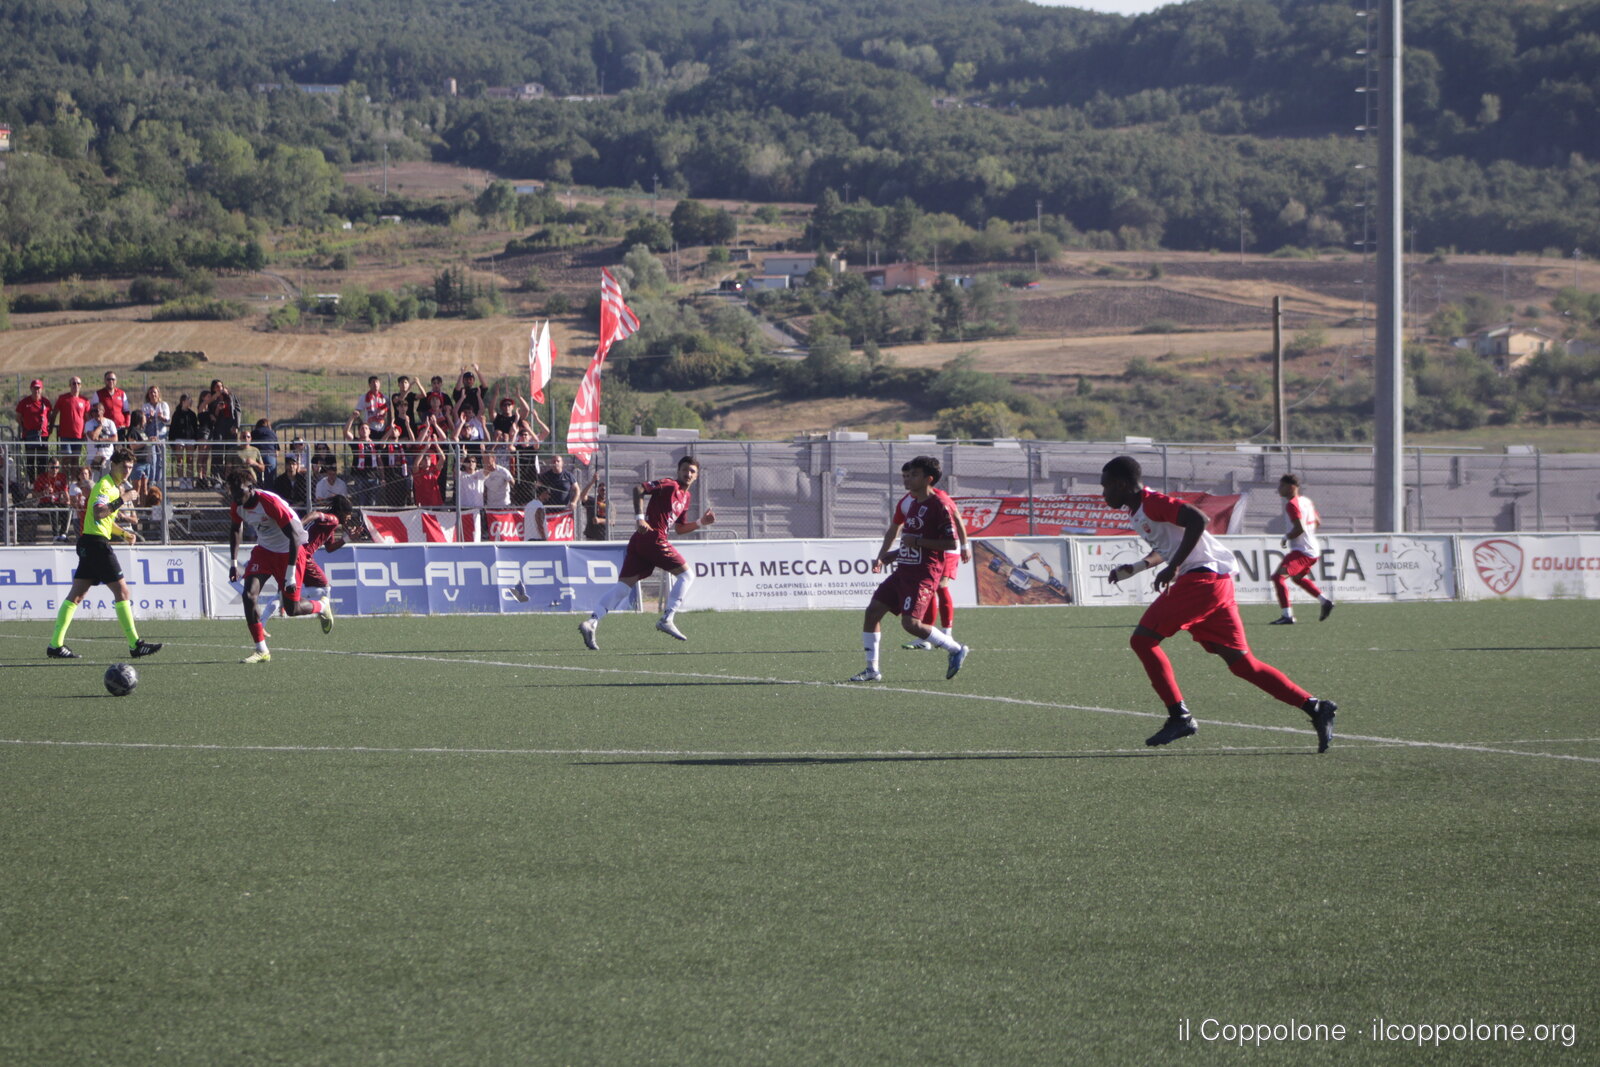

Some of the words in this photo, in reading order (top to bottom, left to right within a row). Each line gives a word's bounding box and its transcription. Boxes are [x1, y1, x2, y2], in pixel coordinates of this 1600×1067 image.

[1057, 510, 1086, 519] FARE
[1103, 512, 1130, 521] MOD
[324, 561, 619, 587] COLANGELO
[695, 561, 754, 577] DITTA
[760, 560, 833, 576] MECCA
[817, 588, 875, 596] DOMENICOMECC
[904, 596, 911, 610] 8
